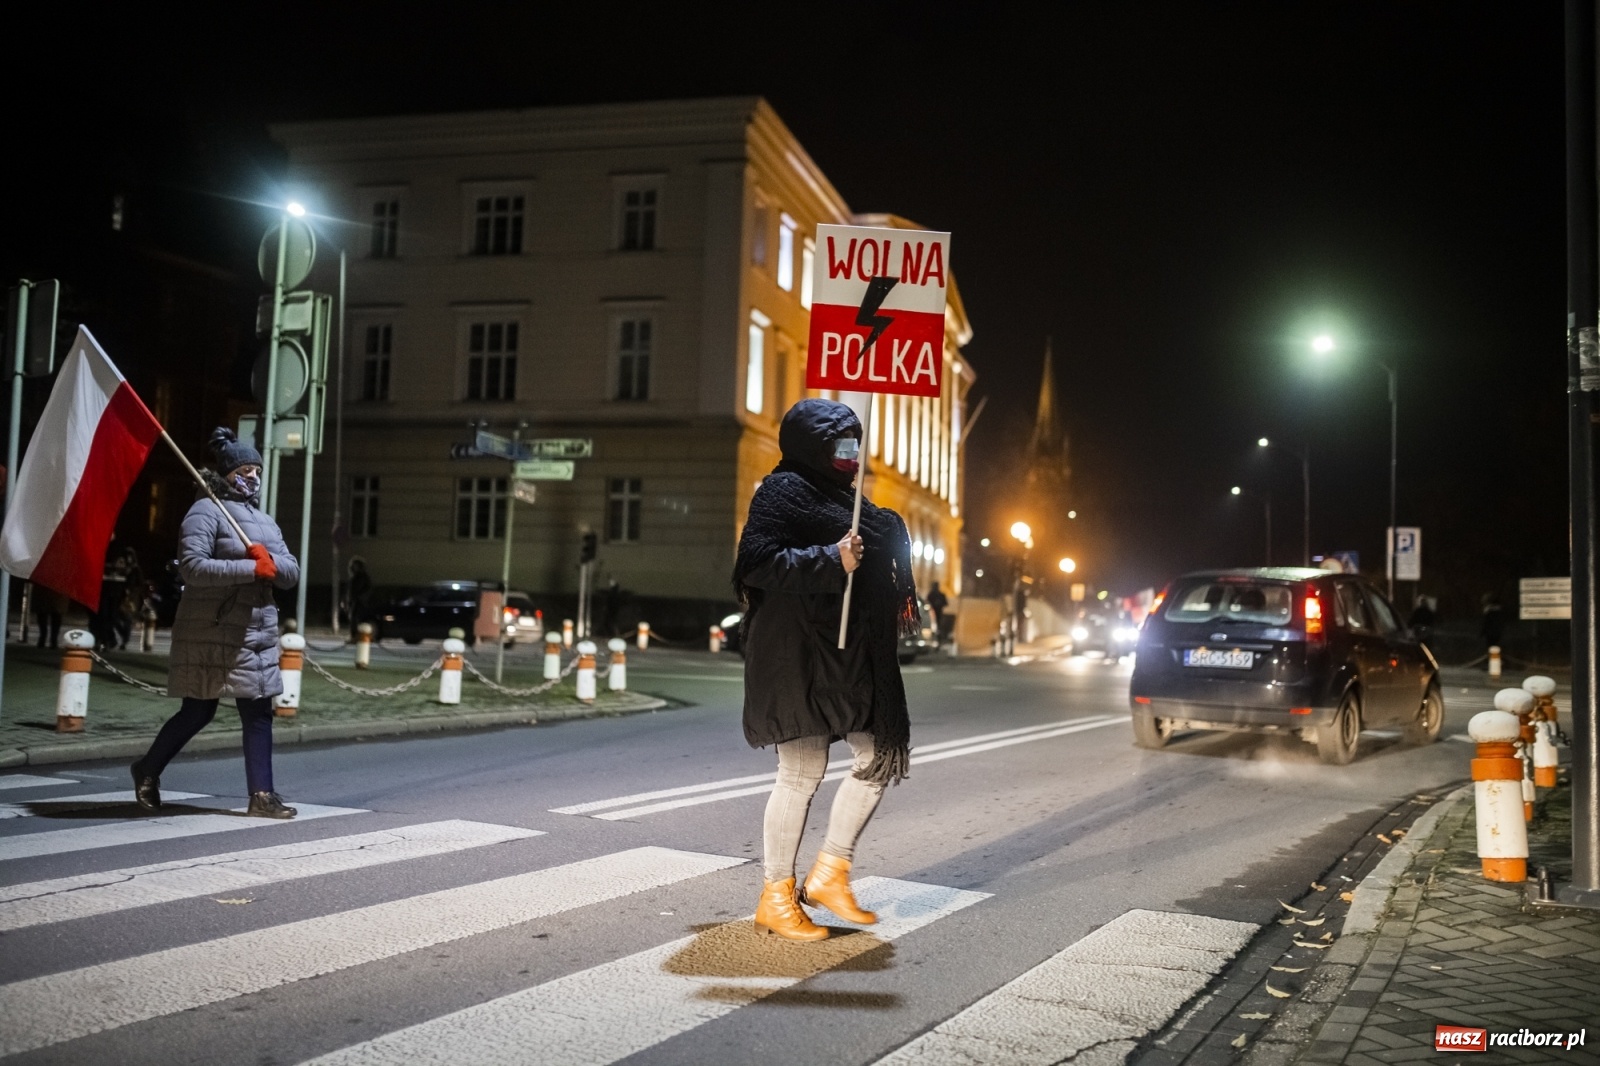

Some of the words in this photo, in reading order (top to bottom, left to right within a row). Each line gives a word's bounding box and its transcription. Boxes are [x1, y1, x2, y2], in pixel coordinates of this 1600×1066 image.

[827, 236, 945, 288] WOLNA
[820, 331, 938, 386] POLKA
[1191, 649, 1216, 664] SRC
